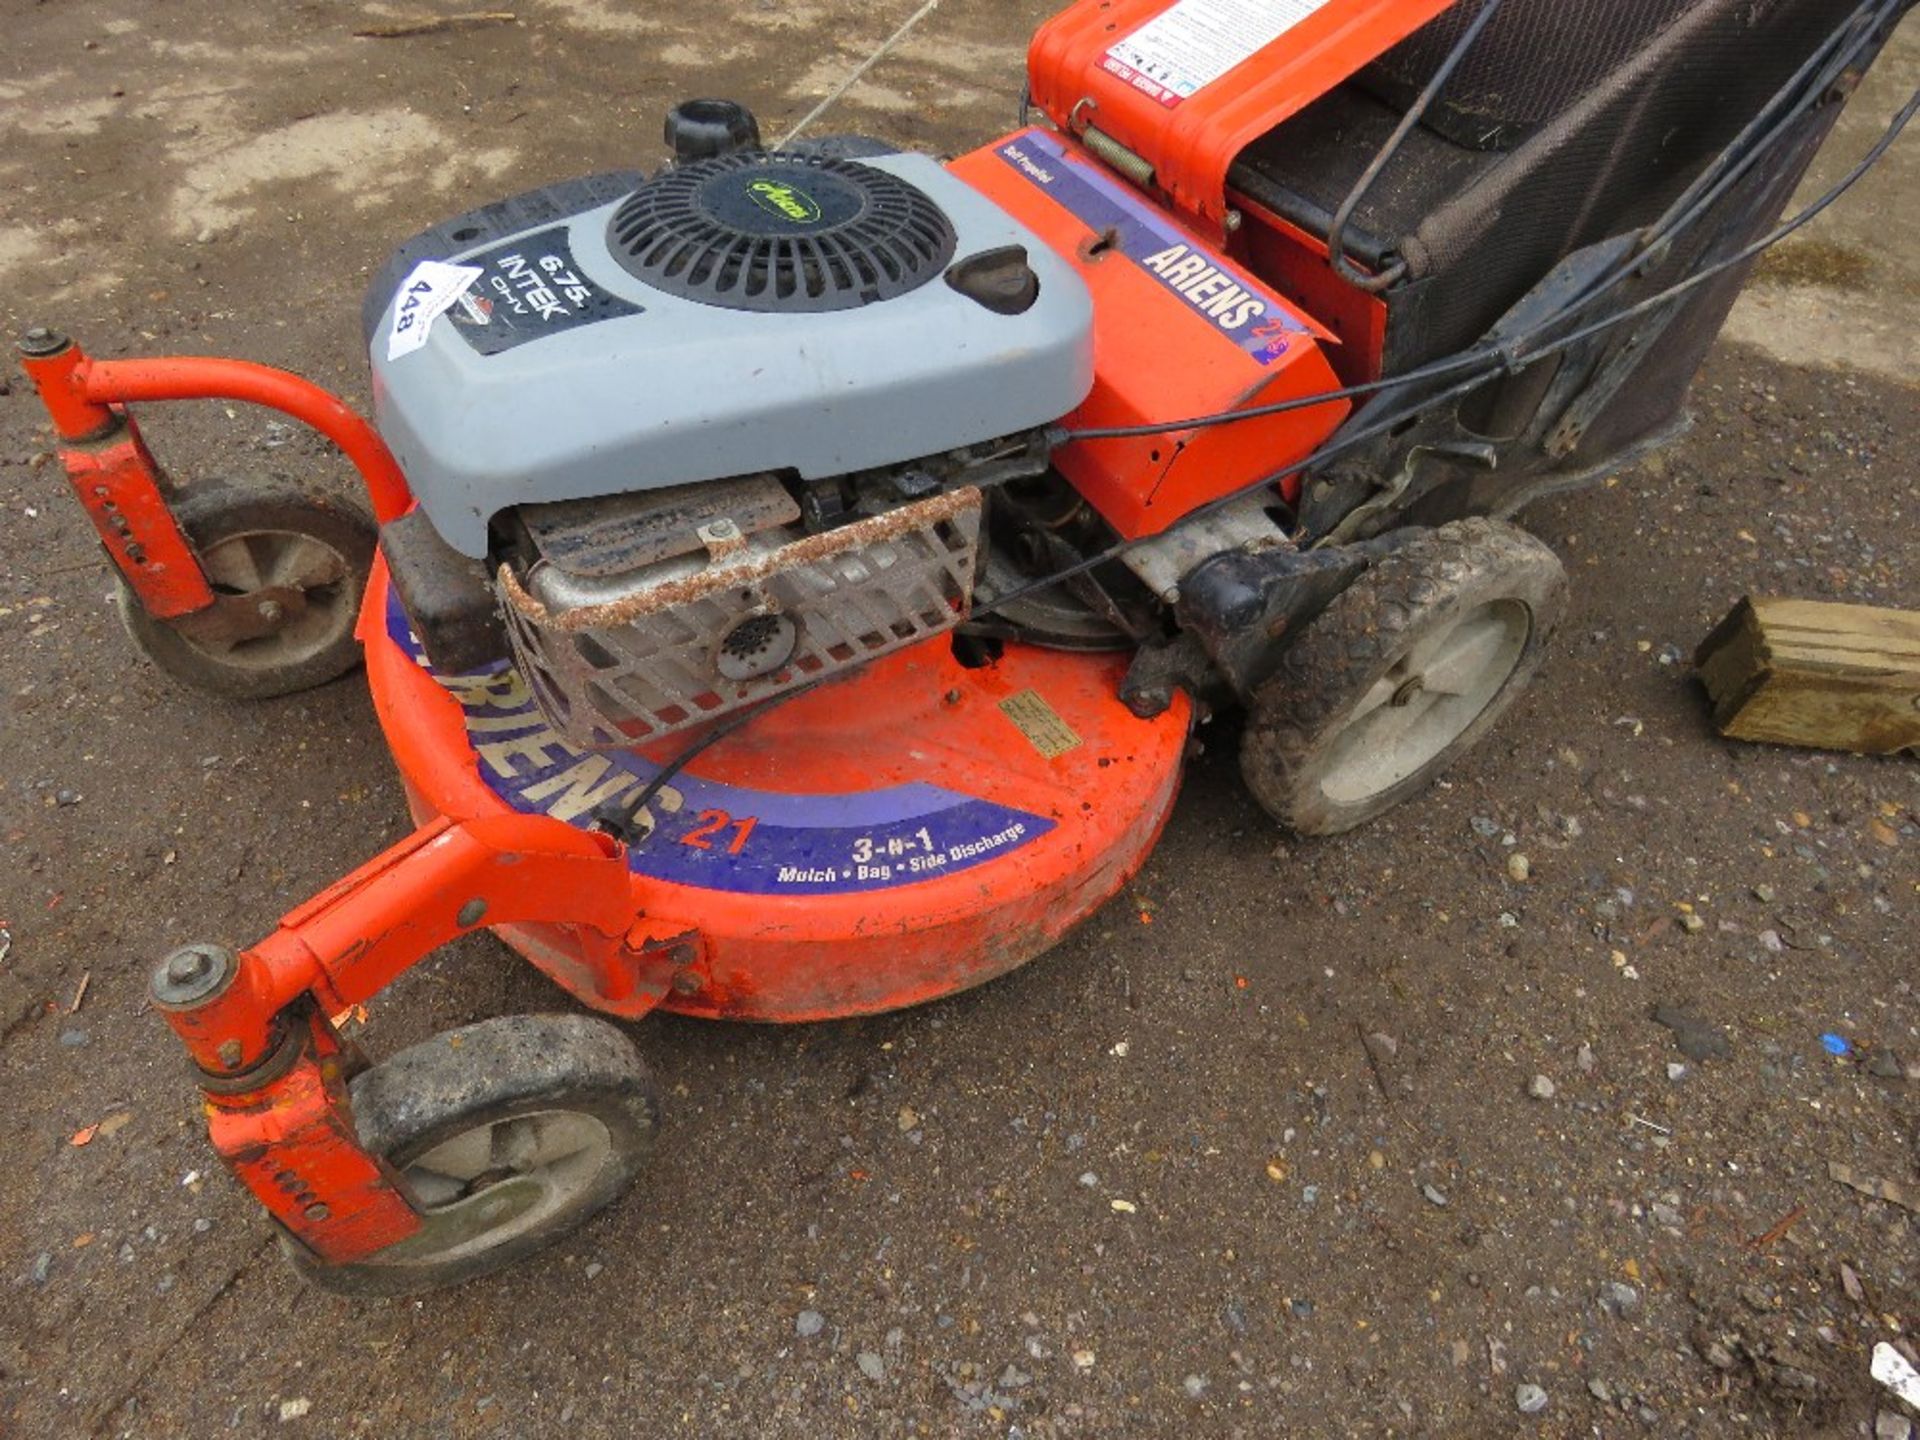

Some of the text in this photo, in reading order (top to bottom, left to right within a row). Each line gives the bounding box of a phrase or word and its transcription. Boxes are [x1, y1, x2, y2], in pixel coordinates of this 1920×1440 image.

[396, 280, 433, 333] 448
[491, 276, 529, 315] OHV
[497, 253, 571, 321] INTEK
[1142, 243, 1265, 330] ARIENS
[409, 631, 760, 855] RIENS 21
[776, 822, 1026, 883] Mulch Bag Side Discharge
